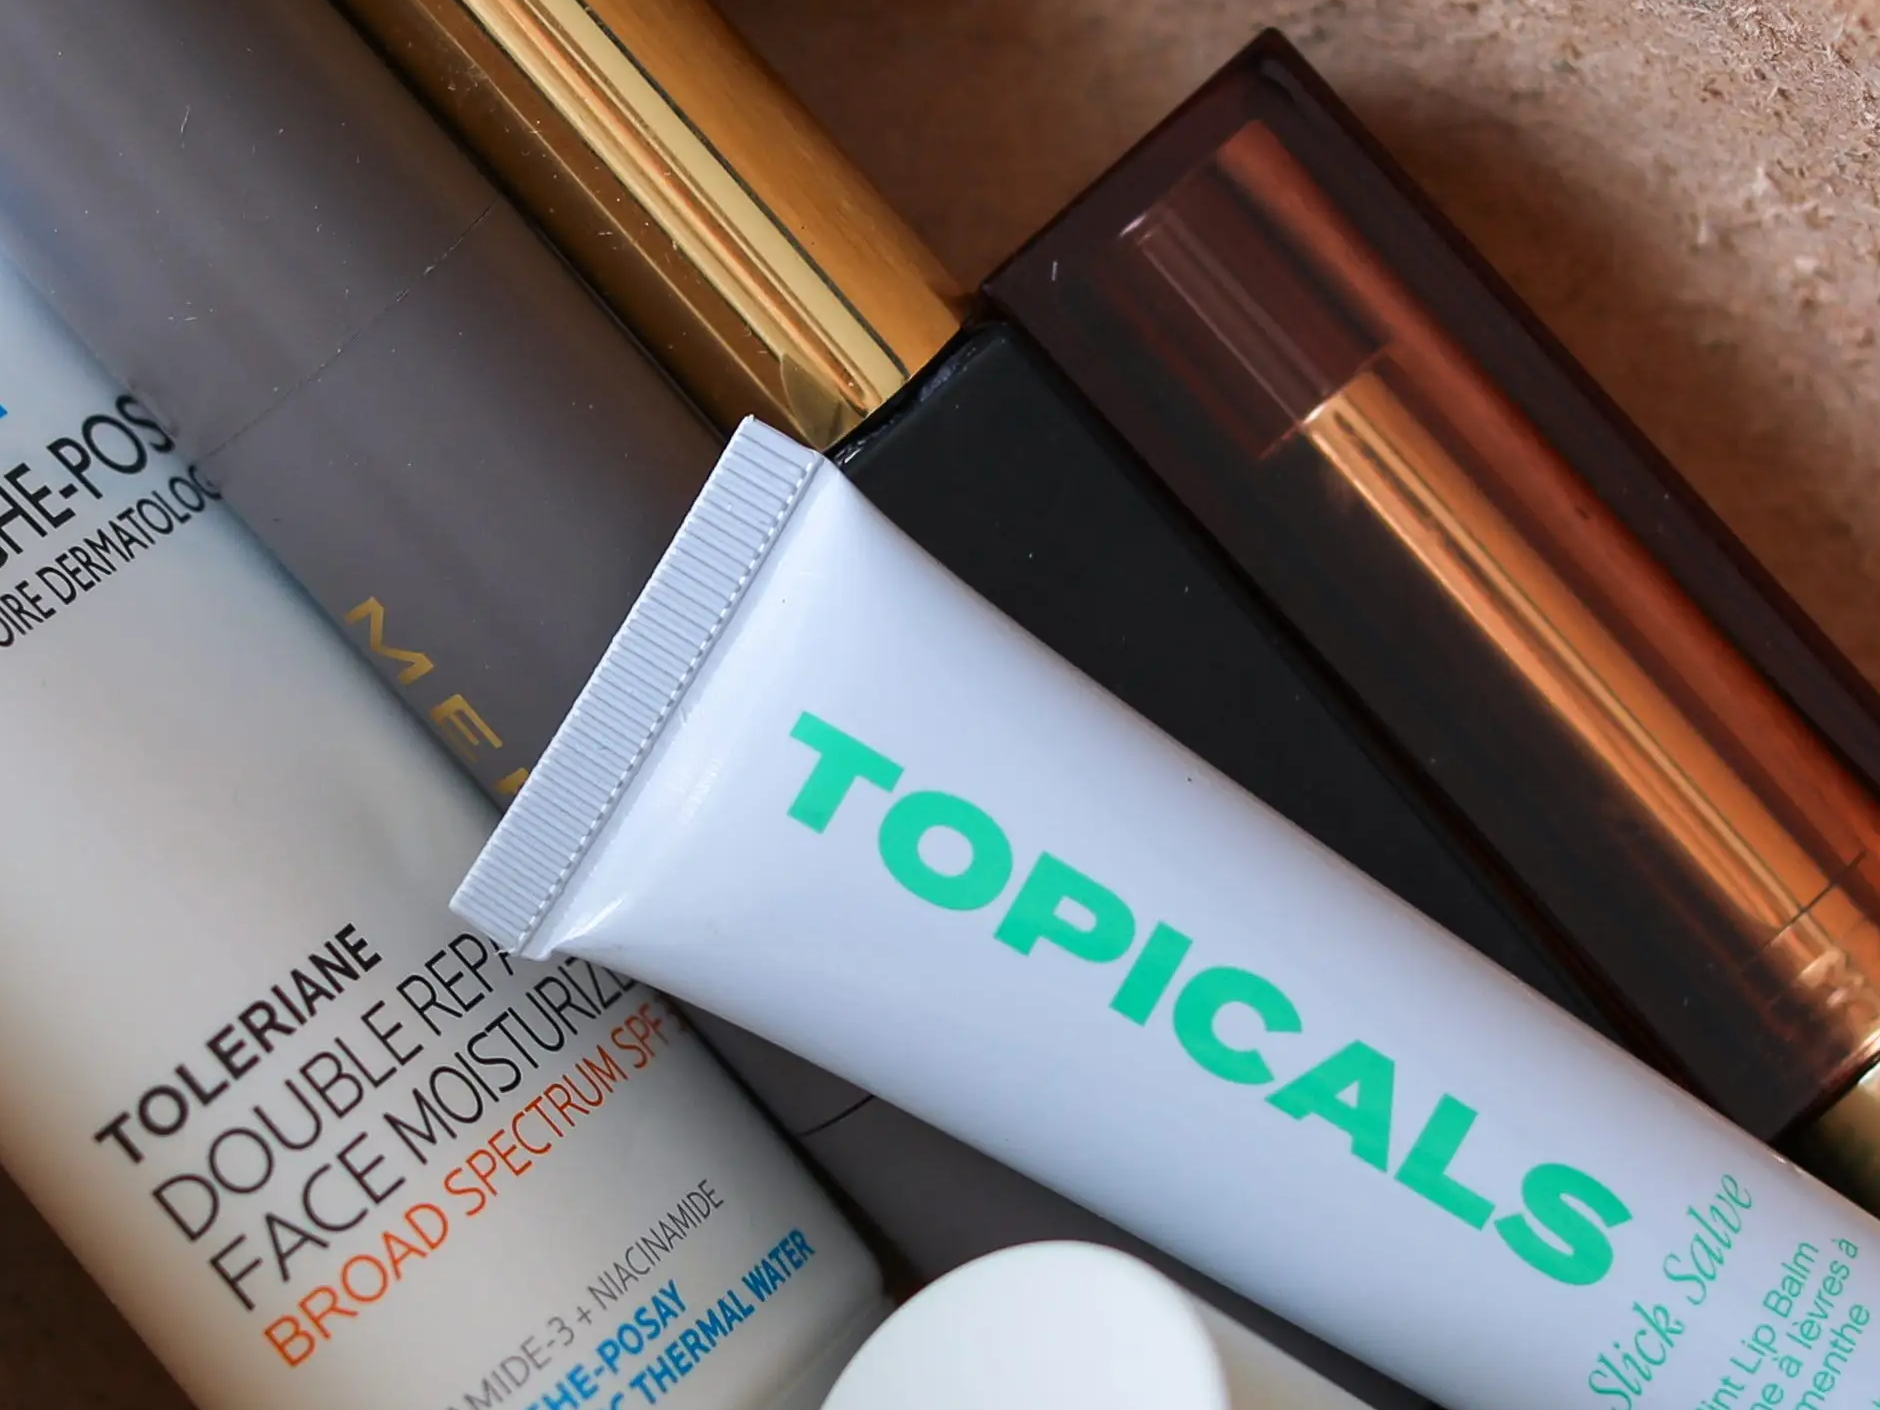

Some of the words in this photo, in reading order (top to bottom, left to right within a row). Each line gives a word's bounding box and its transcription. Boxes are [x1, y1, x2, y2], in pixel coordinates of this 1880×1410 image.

[345, 596, 529, 794] ME
[95, 924, 382, 1163] TOLERIANE
[787, 712, 1632, 1285] TOPICALS
[152, 1001, 423, 1241] DOUBLE
[264, 1203, 448, 1366] BROAD
[444, 1046, 627, 1216] SPECTRUM
[611, 1002, 669, 1070] SPF
[210, 1132, 405, 1310] FACE
[577, 1307, 591, 1324] +
[588, 1180, 723, 1309] NIACINAMIDE
[1663, 1174, 1752, 1305] Salve
[1786, 1259, 1850, 1350] lèvres
[1831, 1238, 1858, 1259] à
[629, 1294, 755, 1404] THERMAL
[743, 1230, 814, 1302] WATER
[1729, 1324, 1777, 1374] Lip
[1762, 1243, 1818, 1318] Balm
[1772, 1354, 1804, 1379] à
